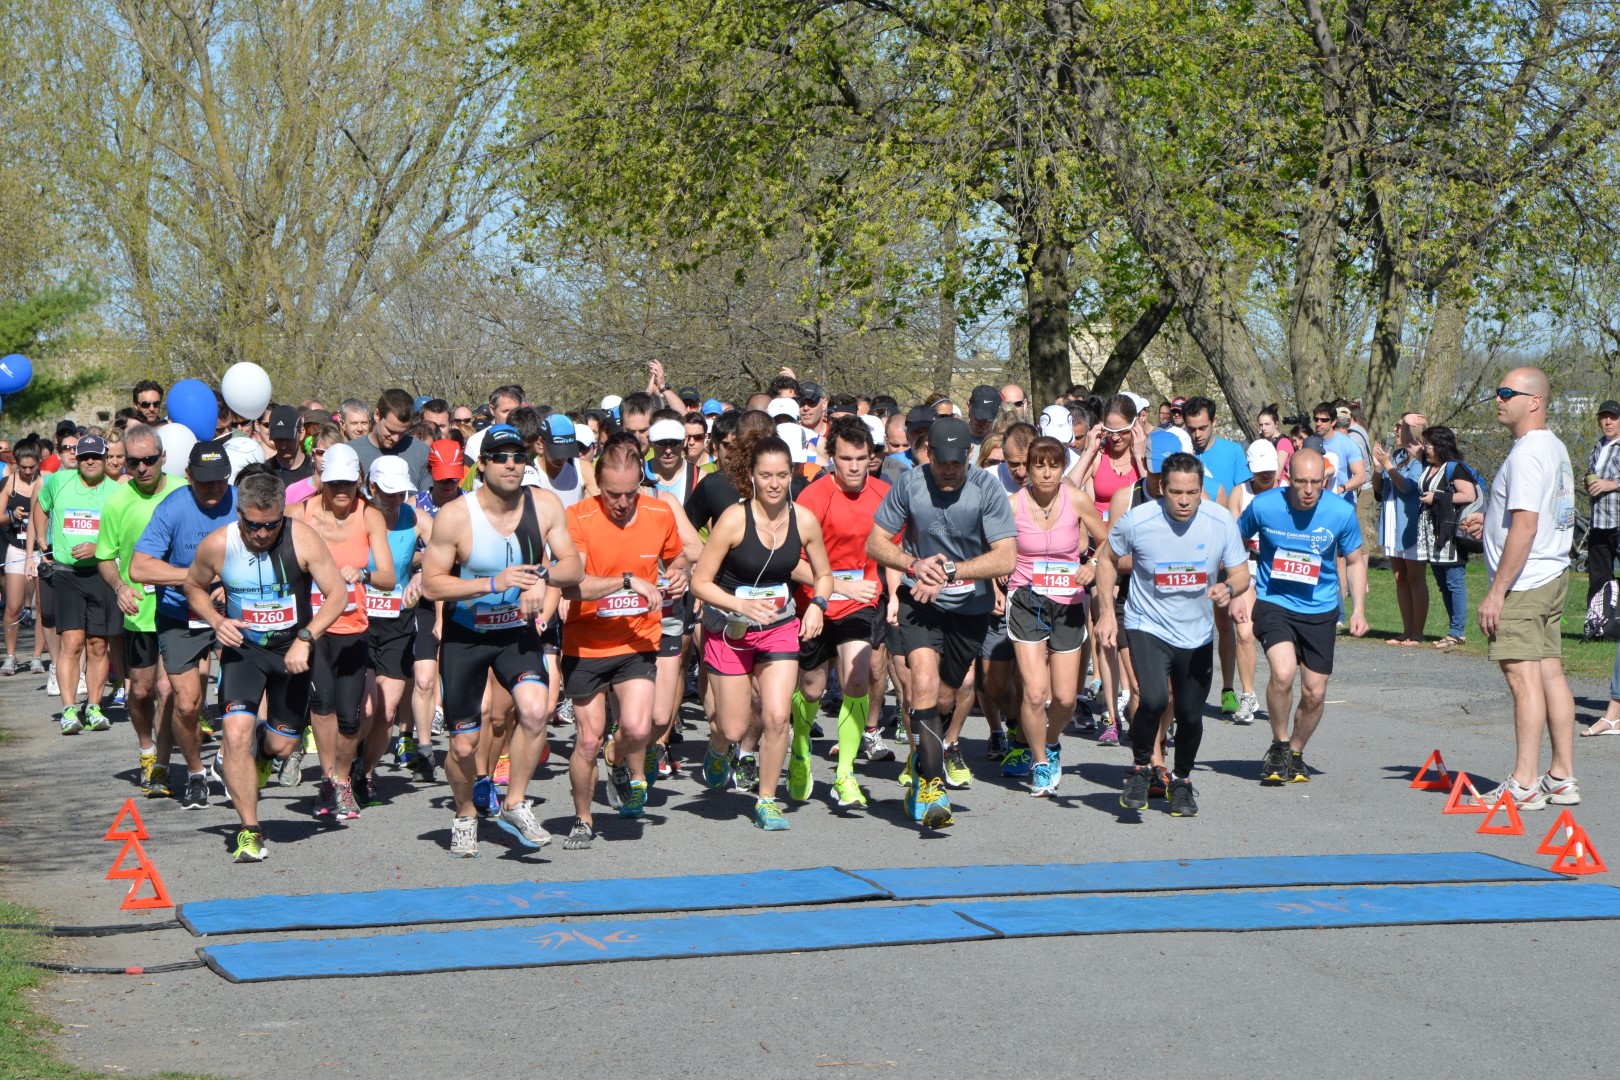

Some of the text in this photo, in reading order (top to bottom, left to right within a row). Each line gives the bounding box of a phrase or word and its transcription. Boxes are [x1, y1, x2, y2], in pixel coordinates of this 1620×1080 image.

[71, 519, 93, 529] 1106
[1283, 561, 1311, 575] 1130
[1043, 575, 1070, 587] 1148
[1166, 573, 1198, 586] 1134
[366, 597, 392, 610] 1124
[607, 596, 640, 609] 1096
[252, 611, 285, 623] 1260
[488, 610, 518, 624] 1109
